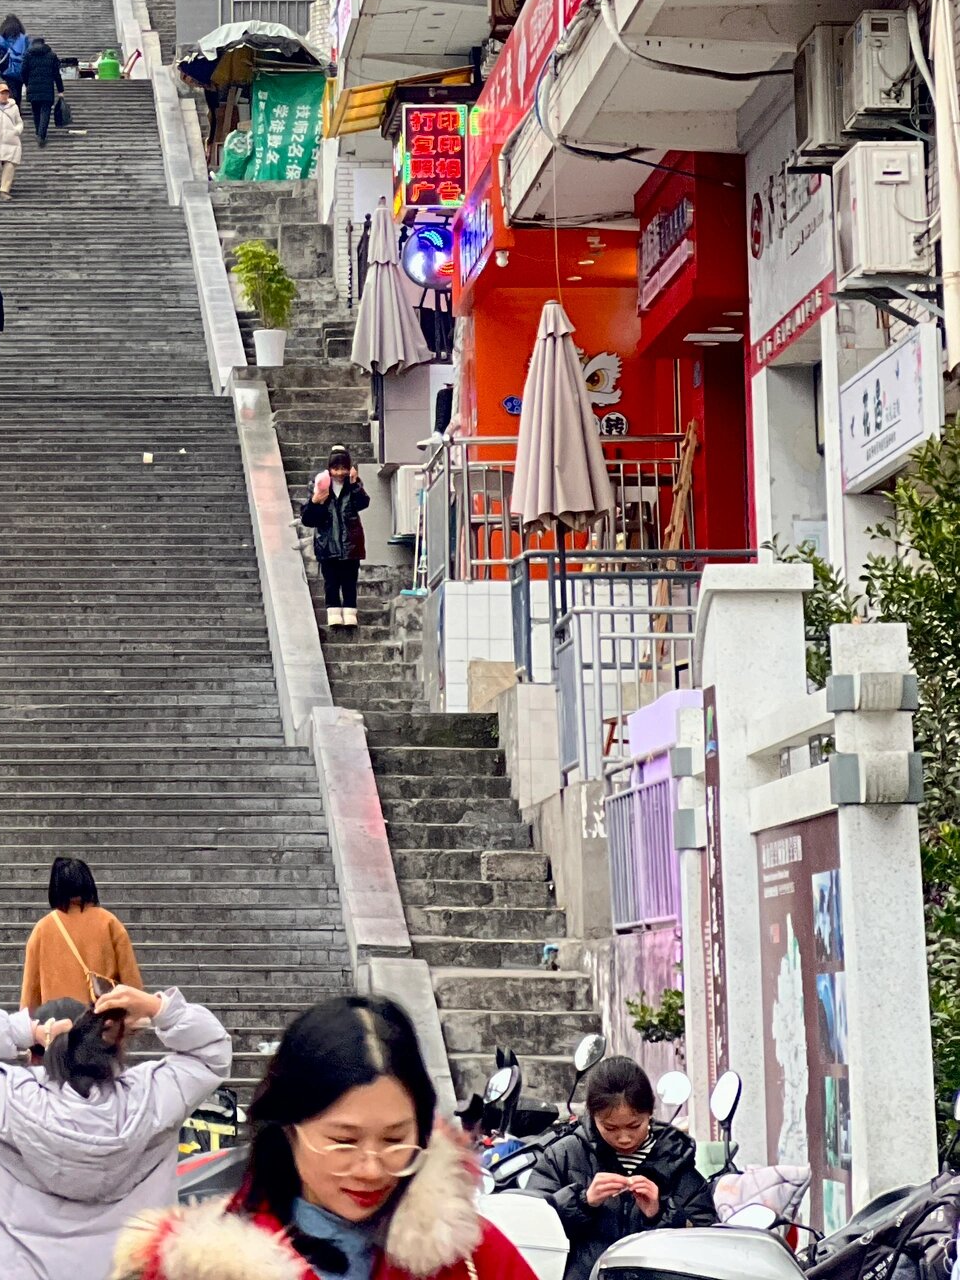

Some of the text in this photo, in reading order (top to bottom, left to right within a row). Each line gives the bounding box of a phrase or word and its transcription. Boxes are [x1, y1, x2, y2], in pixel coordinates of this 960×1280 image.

[410, 111, 461, 132] 打印
[411, 135, 461, 155] 复印
[411, 158, 461, 179] 照相
[410, 181, 461, 202] 广告
